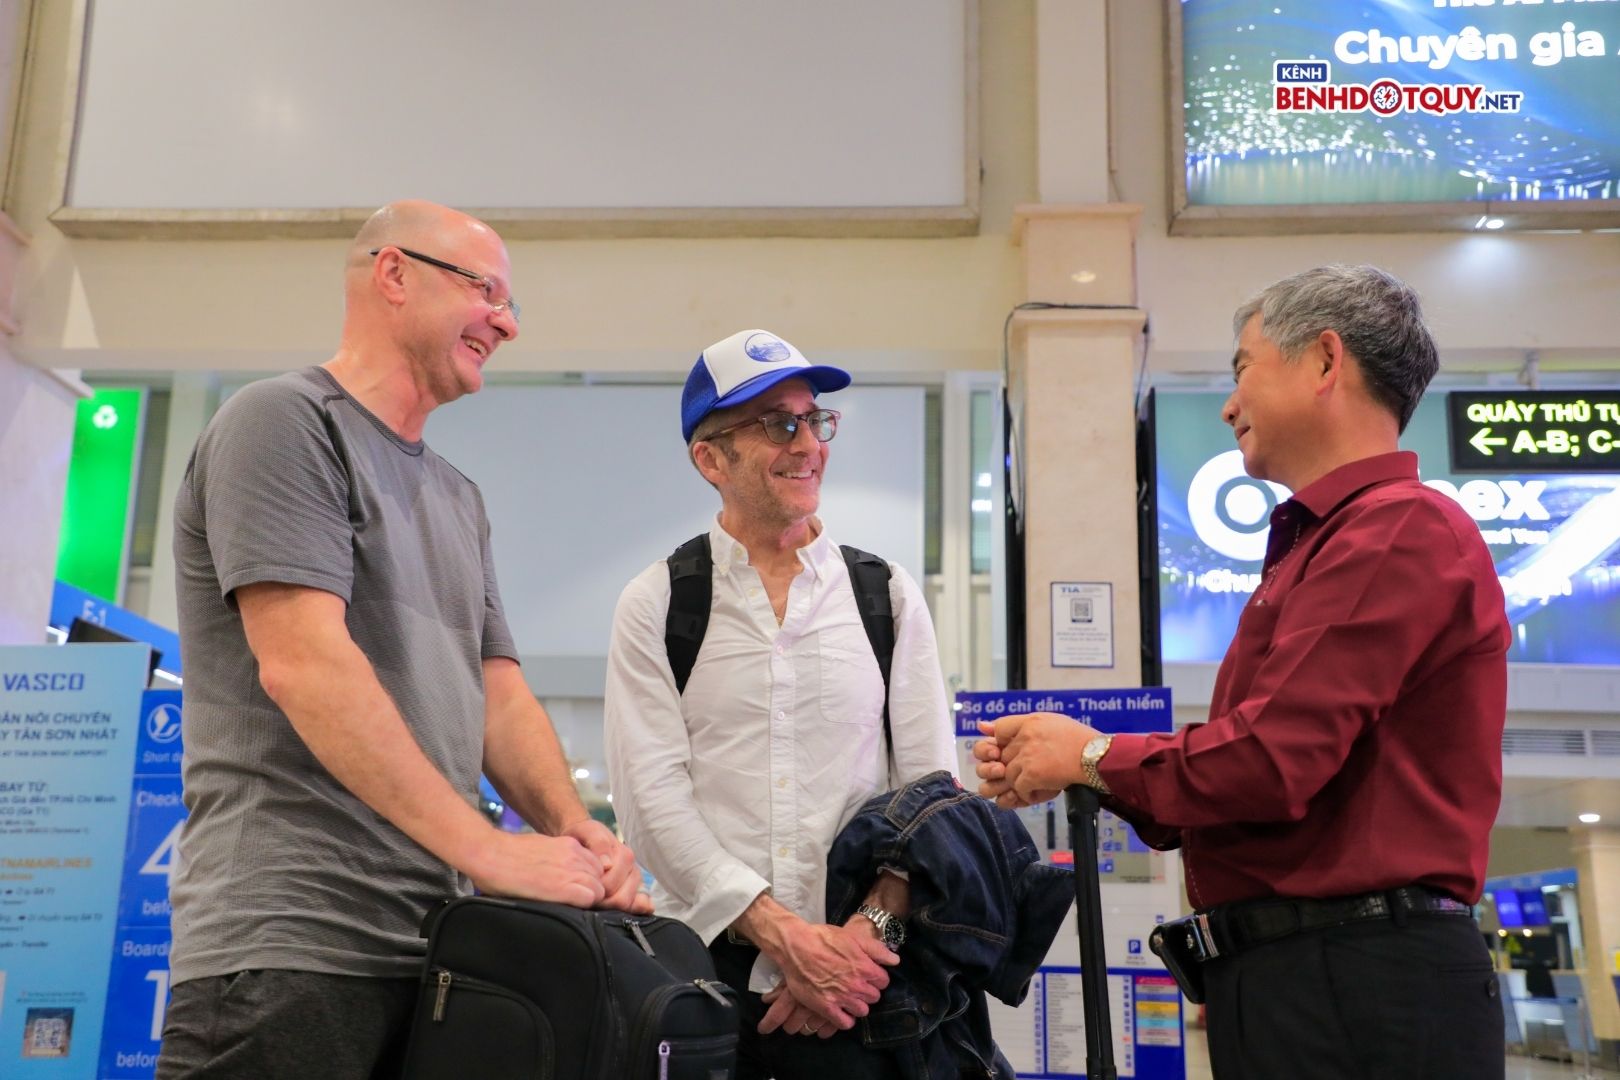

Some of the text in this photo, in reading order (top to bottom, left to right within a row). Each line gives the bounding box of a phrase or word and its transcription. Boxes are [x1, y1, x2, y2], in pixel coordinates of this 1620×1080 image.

[1334, 21, 1605, 69] Chuyên gia
[1539, 400, 1591, 422] THỦ
[1594, 403, 1620, 425] TỤ
[1204, 568, 1261, 593] Chu
[3, 672, 85, 691] VASCO
[962, 700, 982, 714] Sơ
[1078, 696, 1122, 712] Thoát
[138, 818, 185, 889] 4
[122, 940, 168, 957] Board
[116, 1051, 158, 1068] befor
